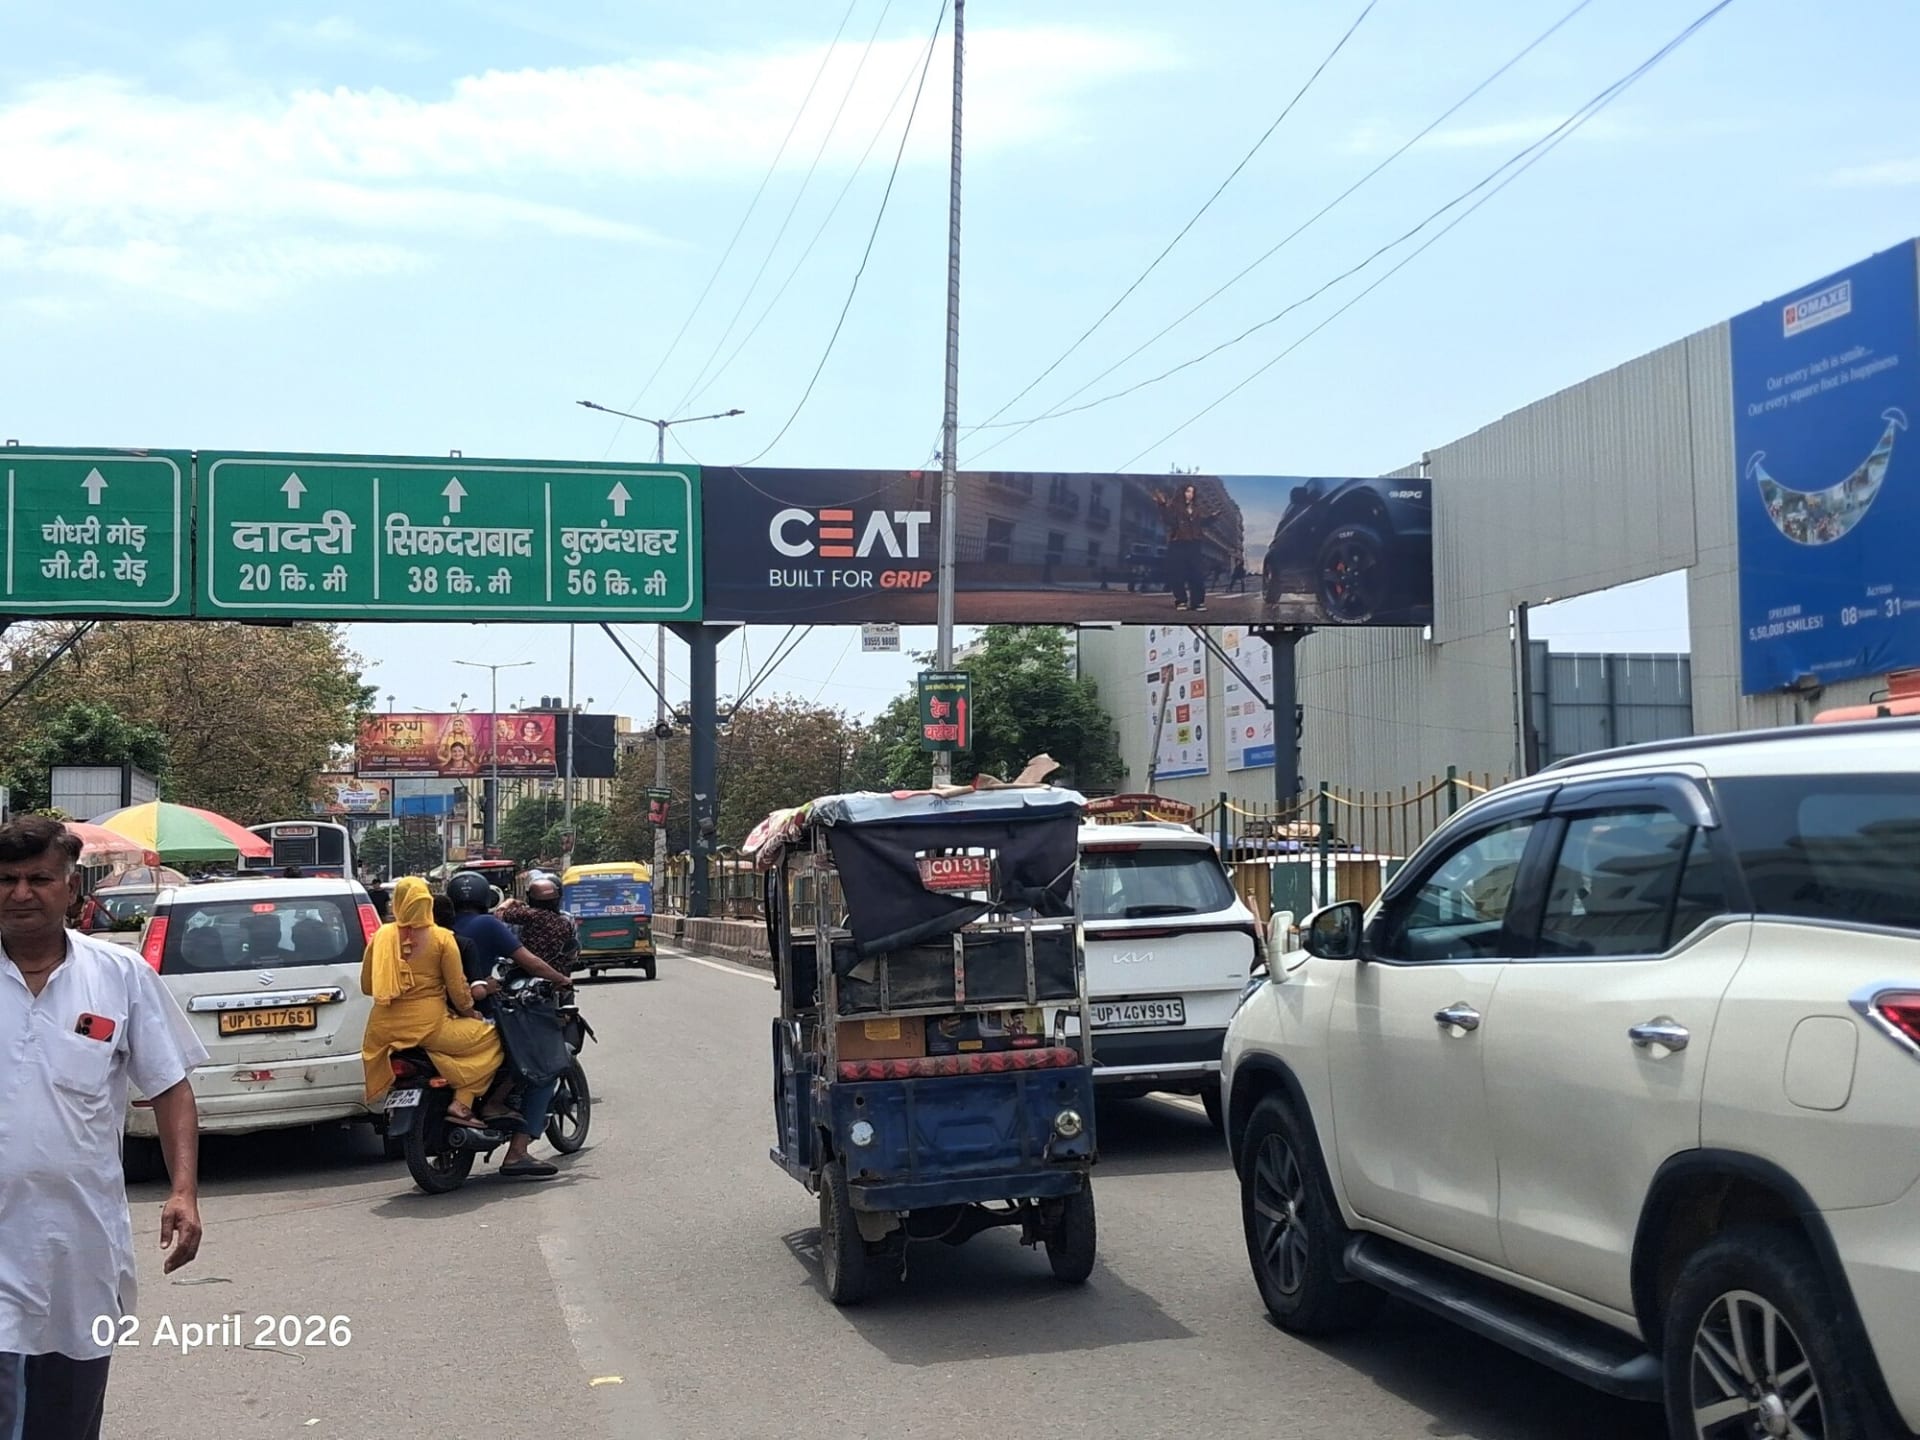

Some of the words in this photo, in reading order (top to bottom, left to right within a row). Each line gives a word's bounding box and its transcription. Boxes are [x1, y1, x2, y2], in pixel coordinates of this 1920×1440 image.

[1798, 287, 1848, 317] OMAXE
[41, 515, 101, 546] चौधरी
[230, 509, 356, 555] दादरी
[385, 512, 534, 558] सिकंदराबाद
[560, 518, 680, 566] बुलंदशहर
[769, 508, 931, 558] CEAT
[239, 563, 271, 592] 20
[322, 564, 348, 592] मी
[408, 566, 439, 594] 38
[487, 567, 512, 595] मी
[567, 569, 597, 595] 56
[644, 569, 668, 597] मी
[769, 569, 824, 588] BUILT
[832, 570, 873, 588] FOR
[879, 570, 932, 588] GRIP
[1786, 615, 1823, 633] SMILES!
[1841, 606, 1857, 626] 08
[1885, 597, 1901, 618] 31
[228, 1009, 312, 1029] UP16JT7661
